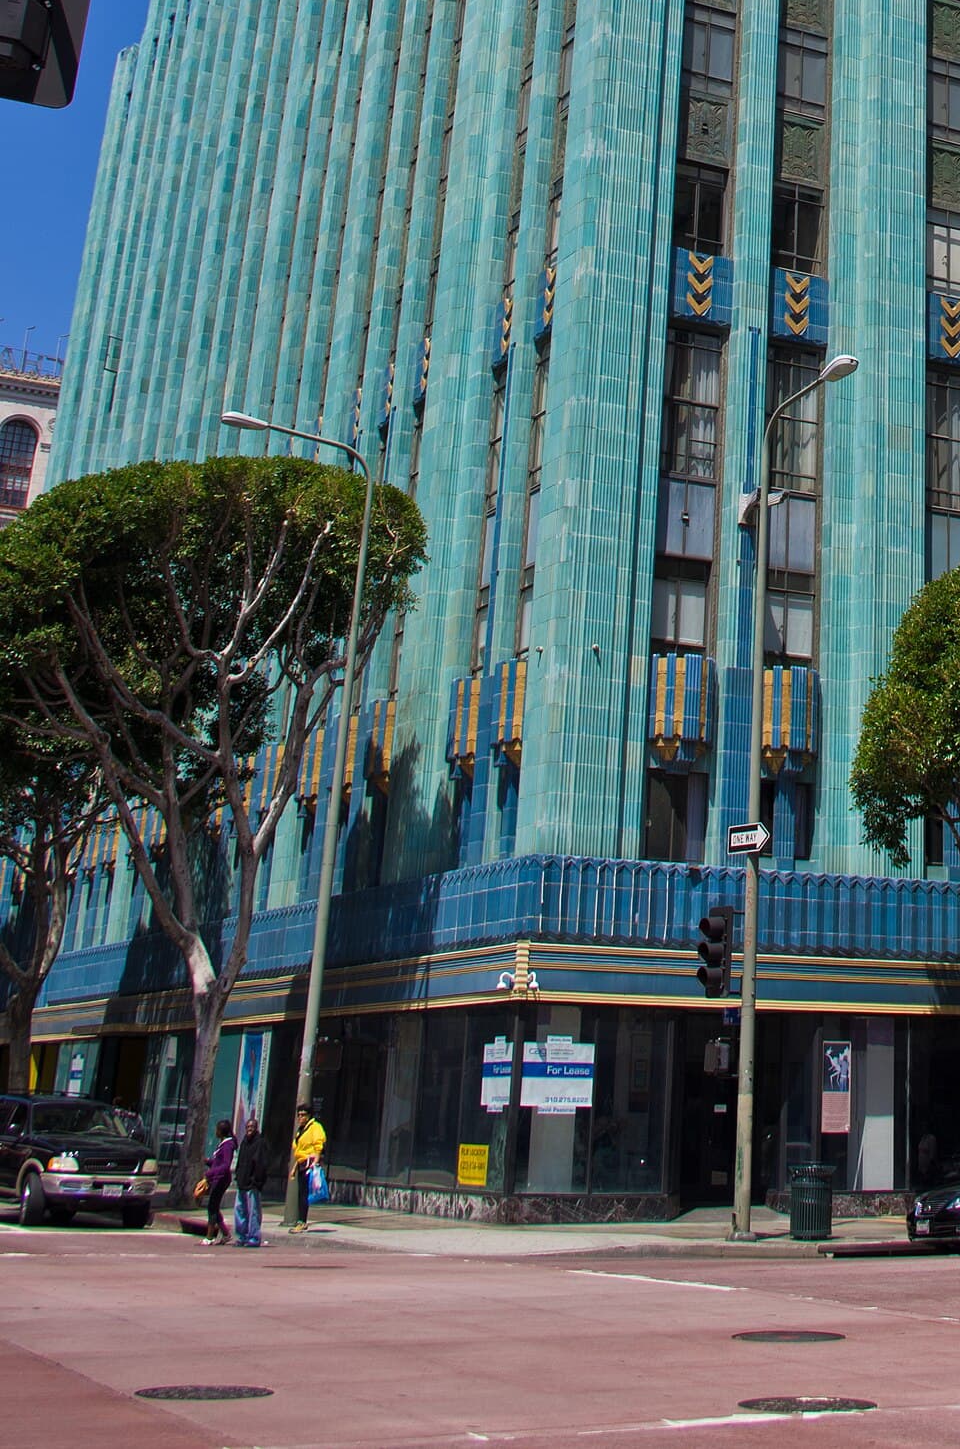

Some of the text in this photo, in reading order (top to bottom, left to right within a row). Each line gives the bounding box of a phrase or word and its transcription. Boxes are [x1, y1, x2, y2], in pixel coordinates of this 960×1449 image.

[732, 832, 758, 845] ONE WAY
[547, 1064, 590, 1076] For Lease
